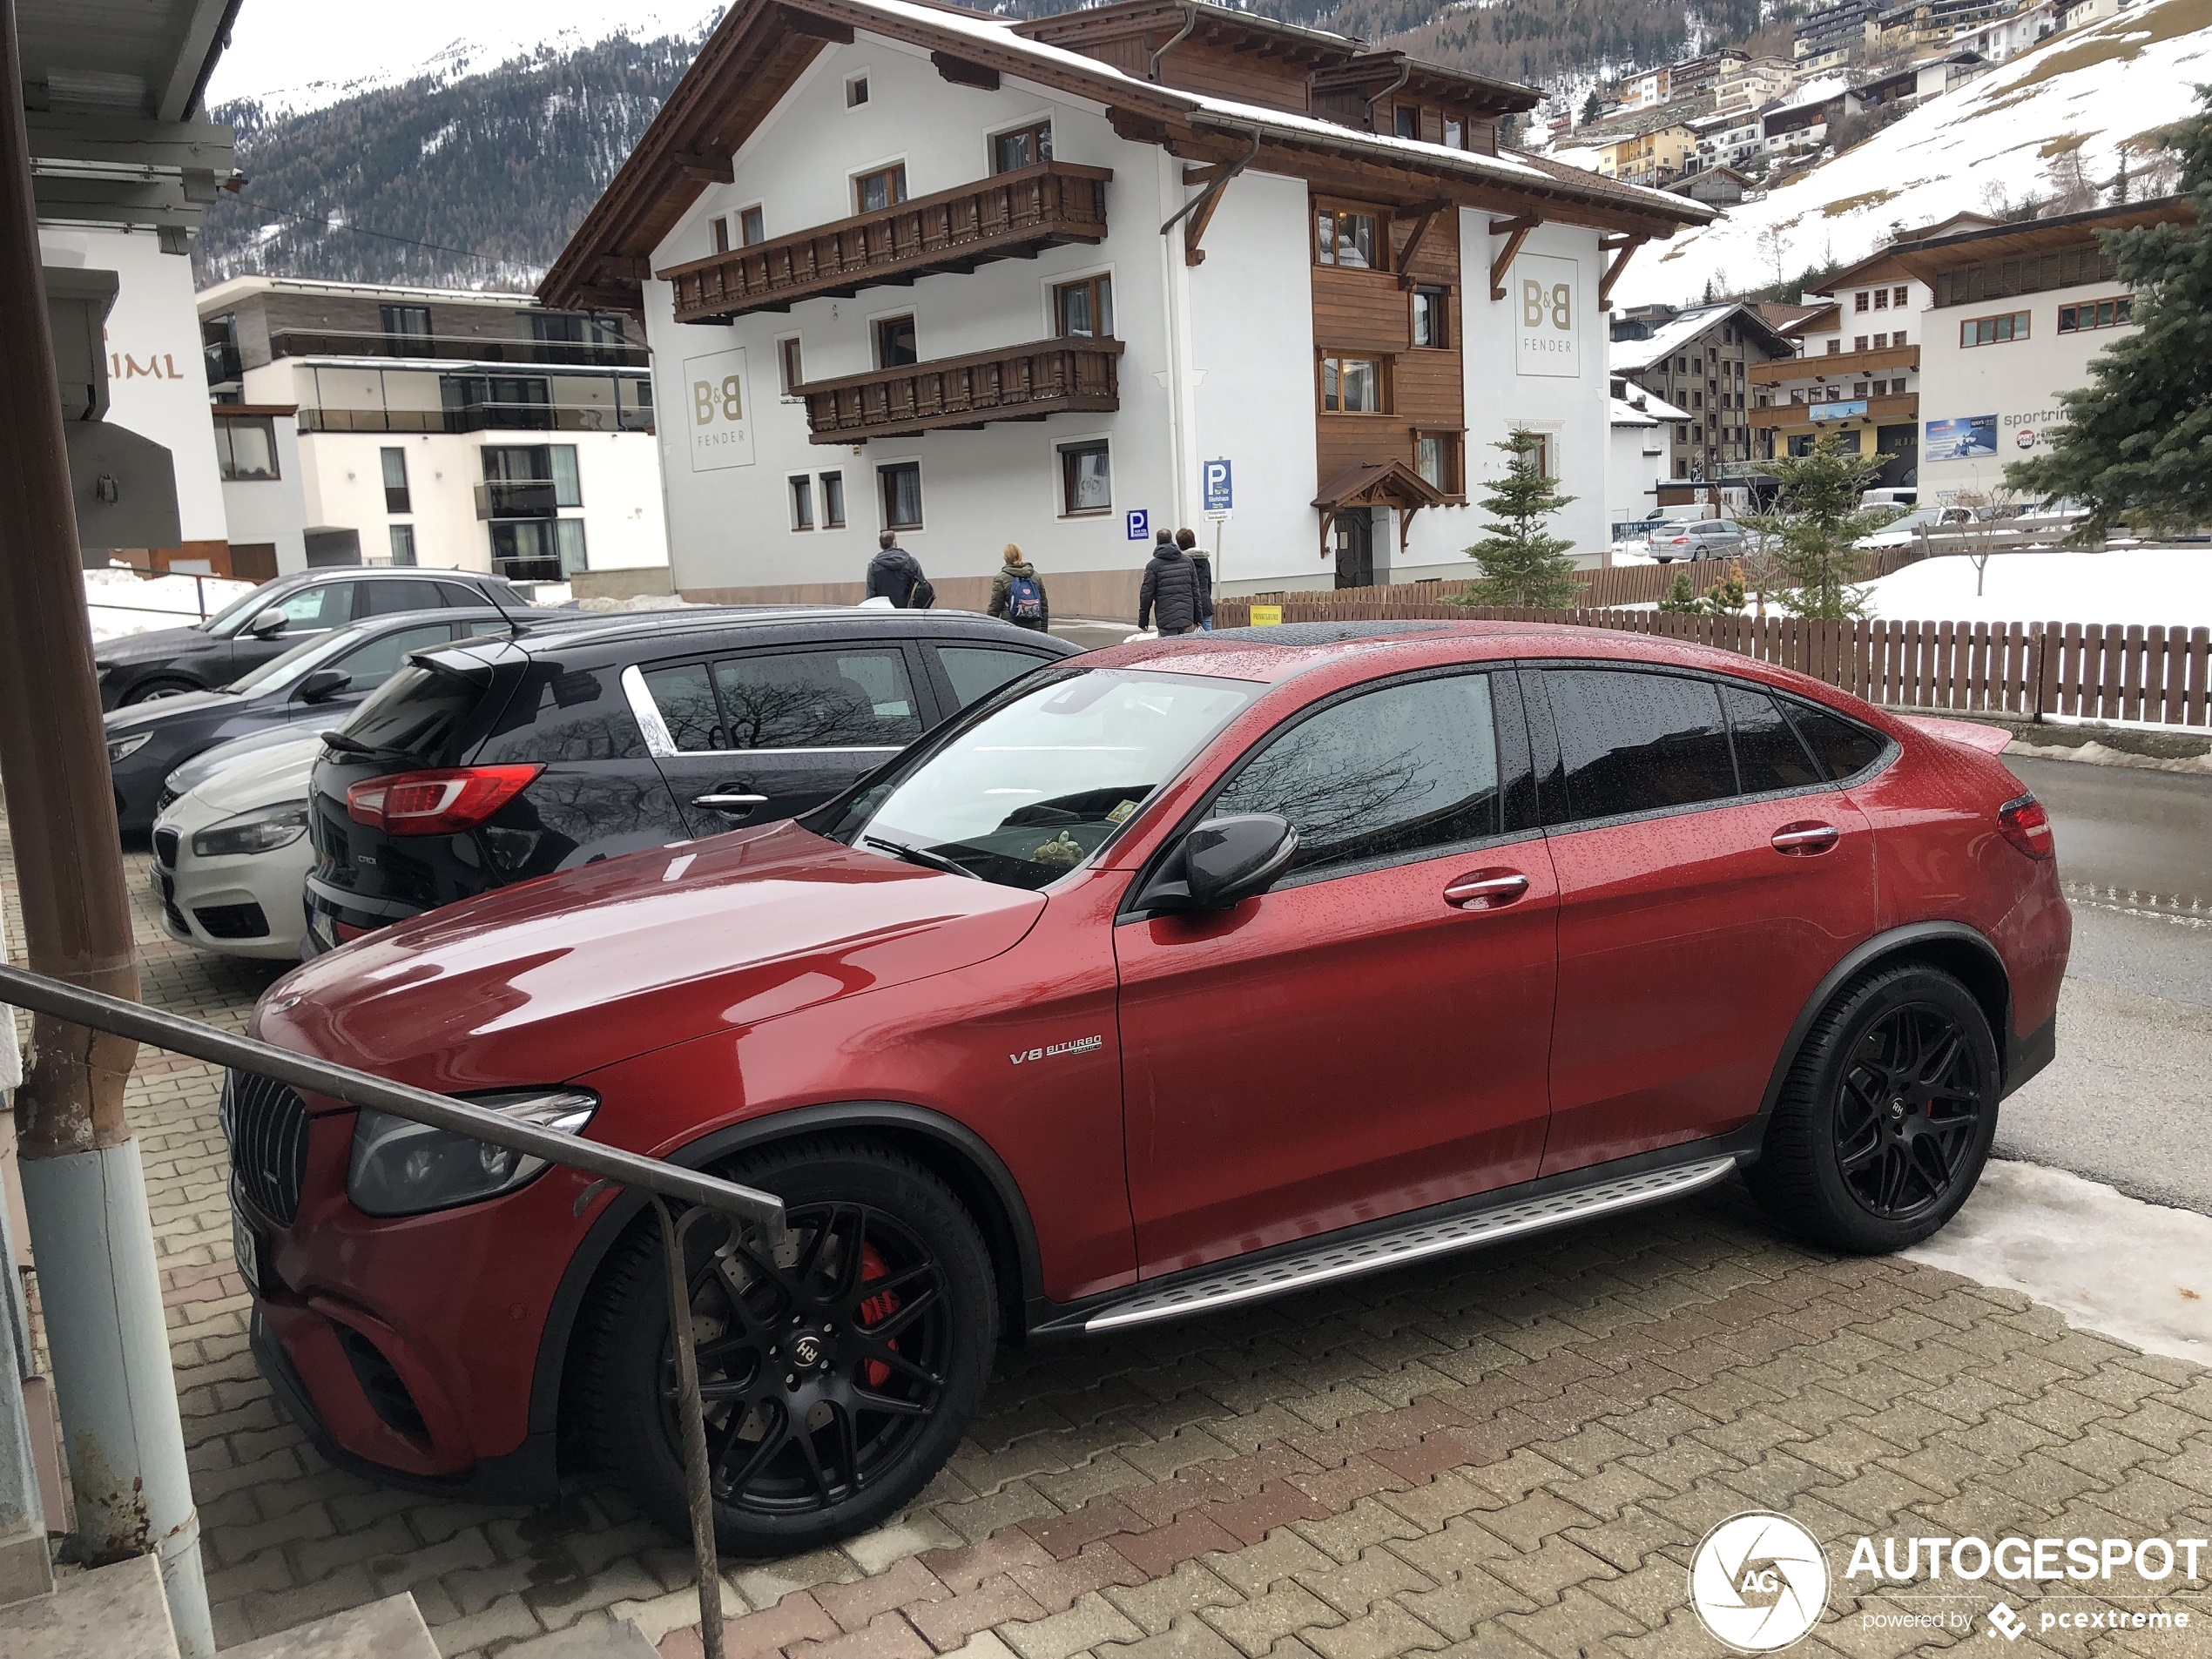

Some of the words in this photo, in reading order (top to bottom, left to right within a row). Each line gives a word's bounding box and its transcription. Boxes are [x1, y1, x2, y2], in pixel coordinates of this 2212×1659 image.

[1522, 279, 1571, 331] B&B
[1524, 338, 1572, 353] FENDER
[108, 352, 185, 380] IML
[693, 374, 743, 426] B&B
[698, 430, 745, 447] FENDER
[1208, 463, 1227, 496] P
[1130, 512, 1145, 538] P
[1009, 1048, 1043, 1065] V8
[1046, 1035, 1102, 1055] BITURBO
[1892, 1102, 1904, 1116] RH
[796, 1341, 819, 1363] RH
